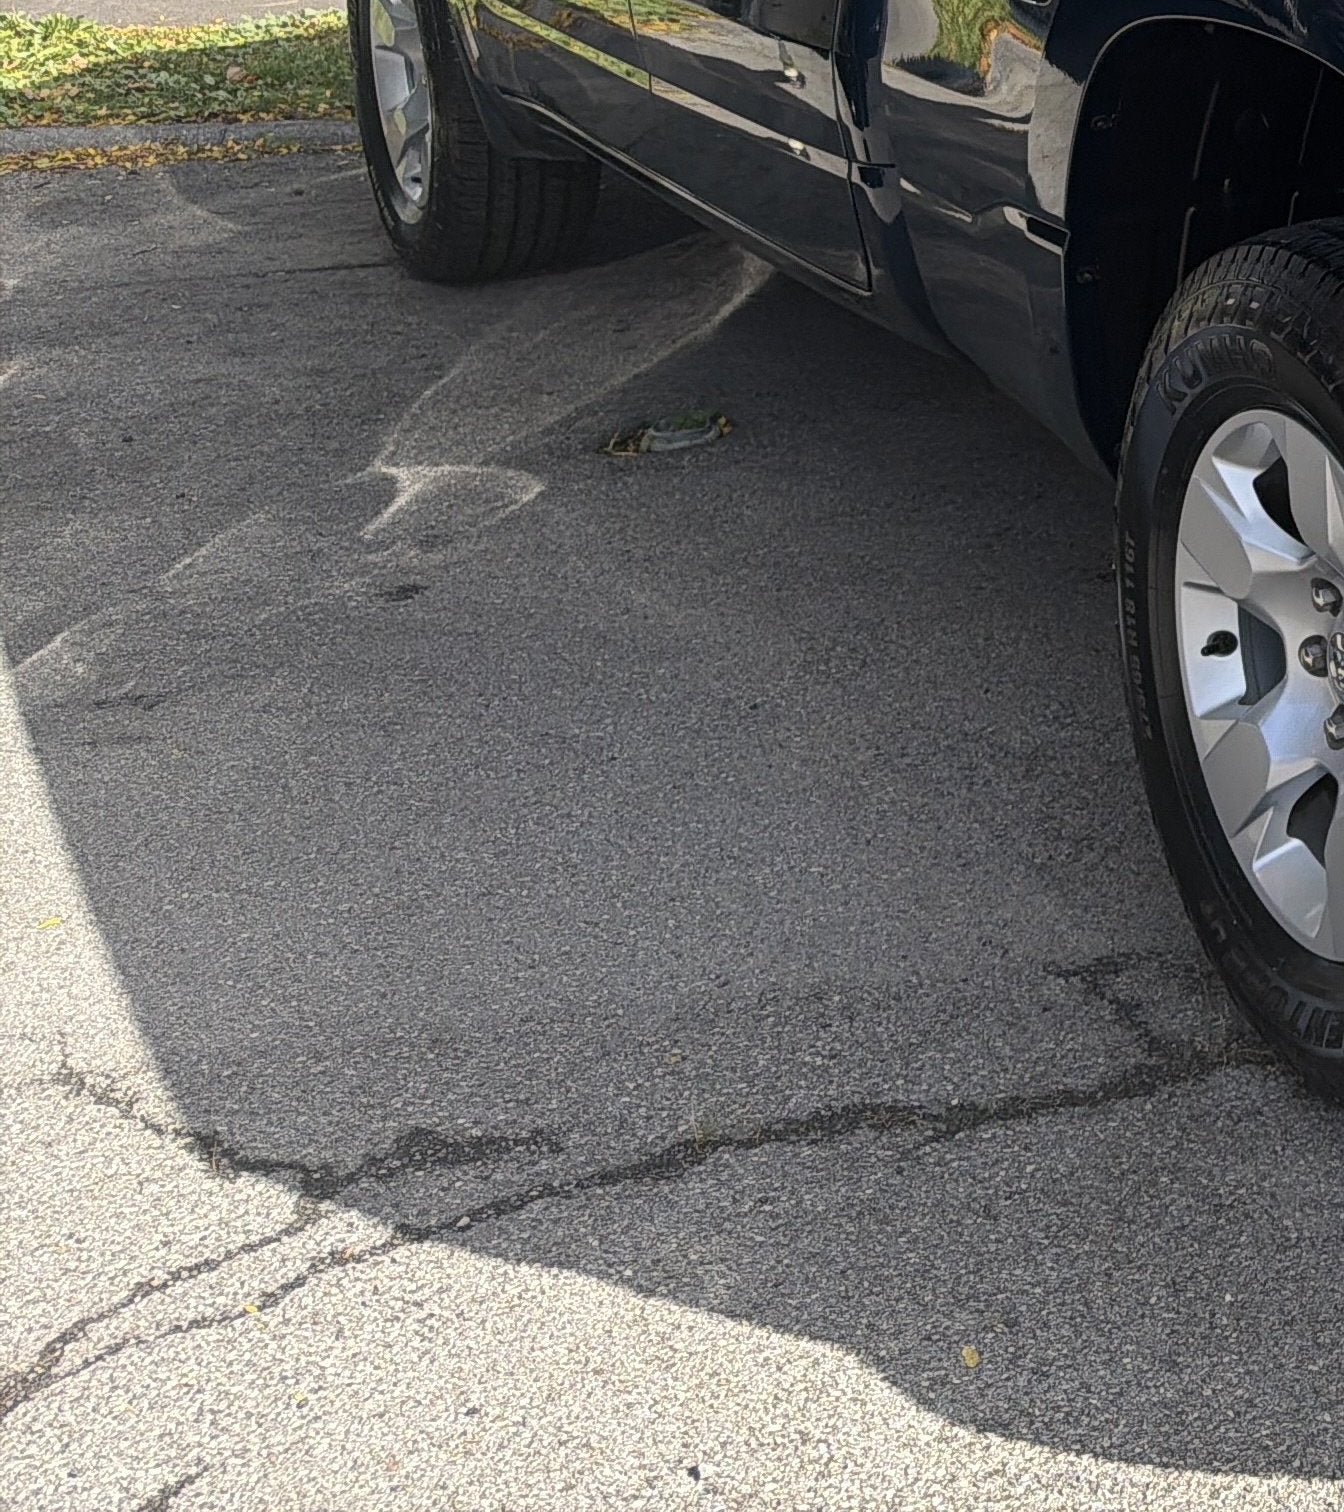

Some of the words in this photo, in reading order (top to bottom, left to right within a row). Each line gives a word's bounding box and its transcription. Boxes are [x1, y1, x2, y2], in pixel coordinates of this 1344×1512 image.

[1155, 332, 1276, 417] KUMHO
[1123, 529, 1136, 589] 116T
[1123, 596, 1139, 648] R18
